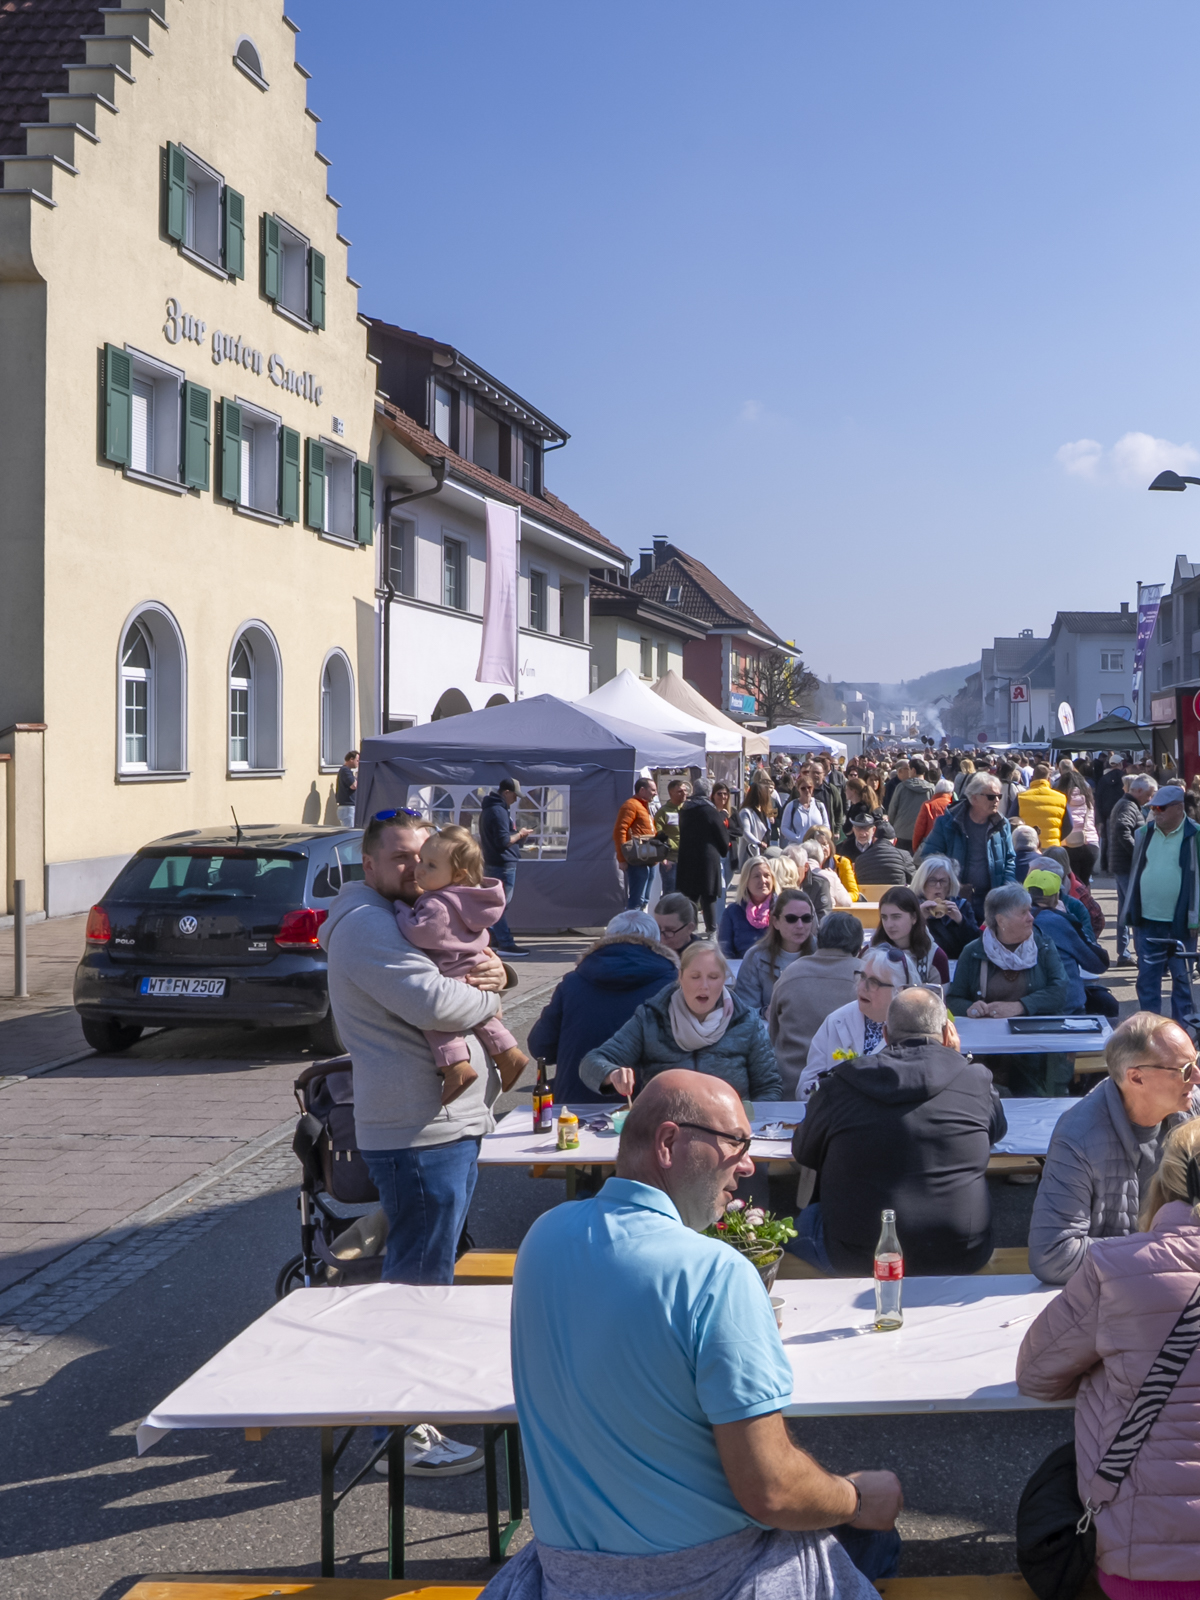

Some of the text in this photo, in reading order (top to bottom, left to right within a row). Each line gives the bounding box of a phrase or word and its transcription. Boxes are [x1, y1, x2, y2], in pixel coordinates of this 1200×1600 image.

[162, 297, 324, 406] Zur guten Quelle
[149, 978, 165, 992] WT
[172, 979, 190, 993] FN
[191, 980, 225, 994] 2507
